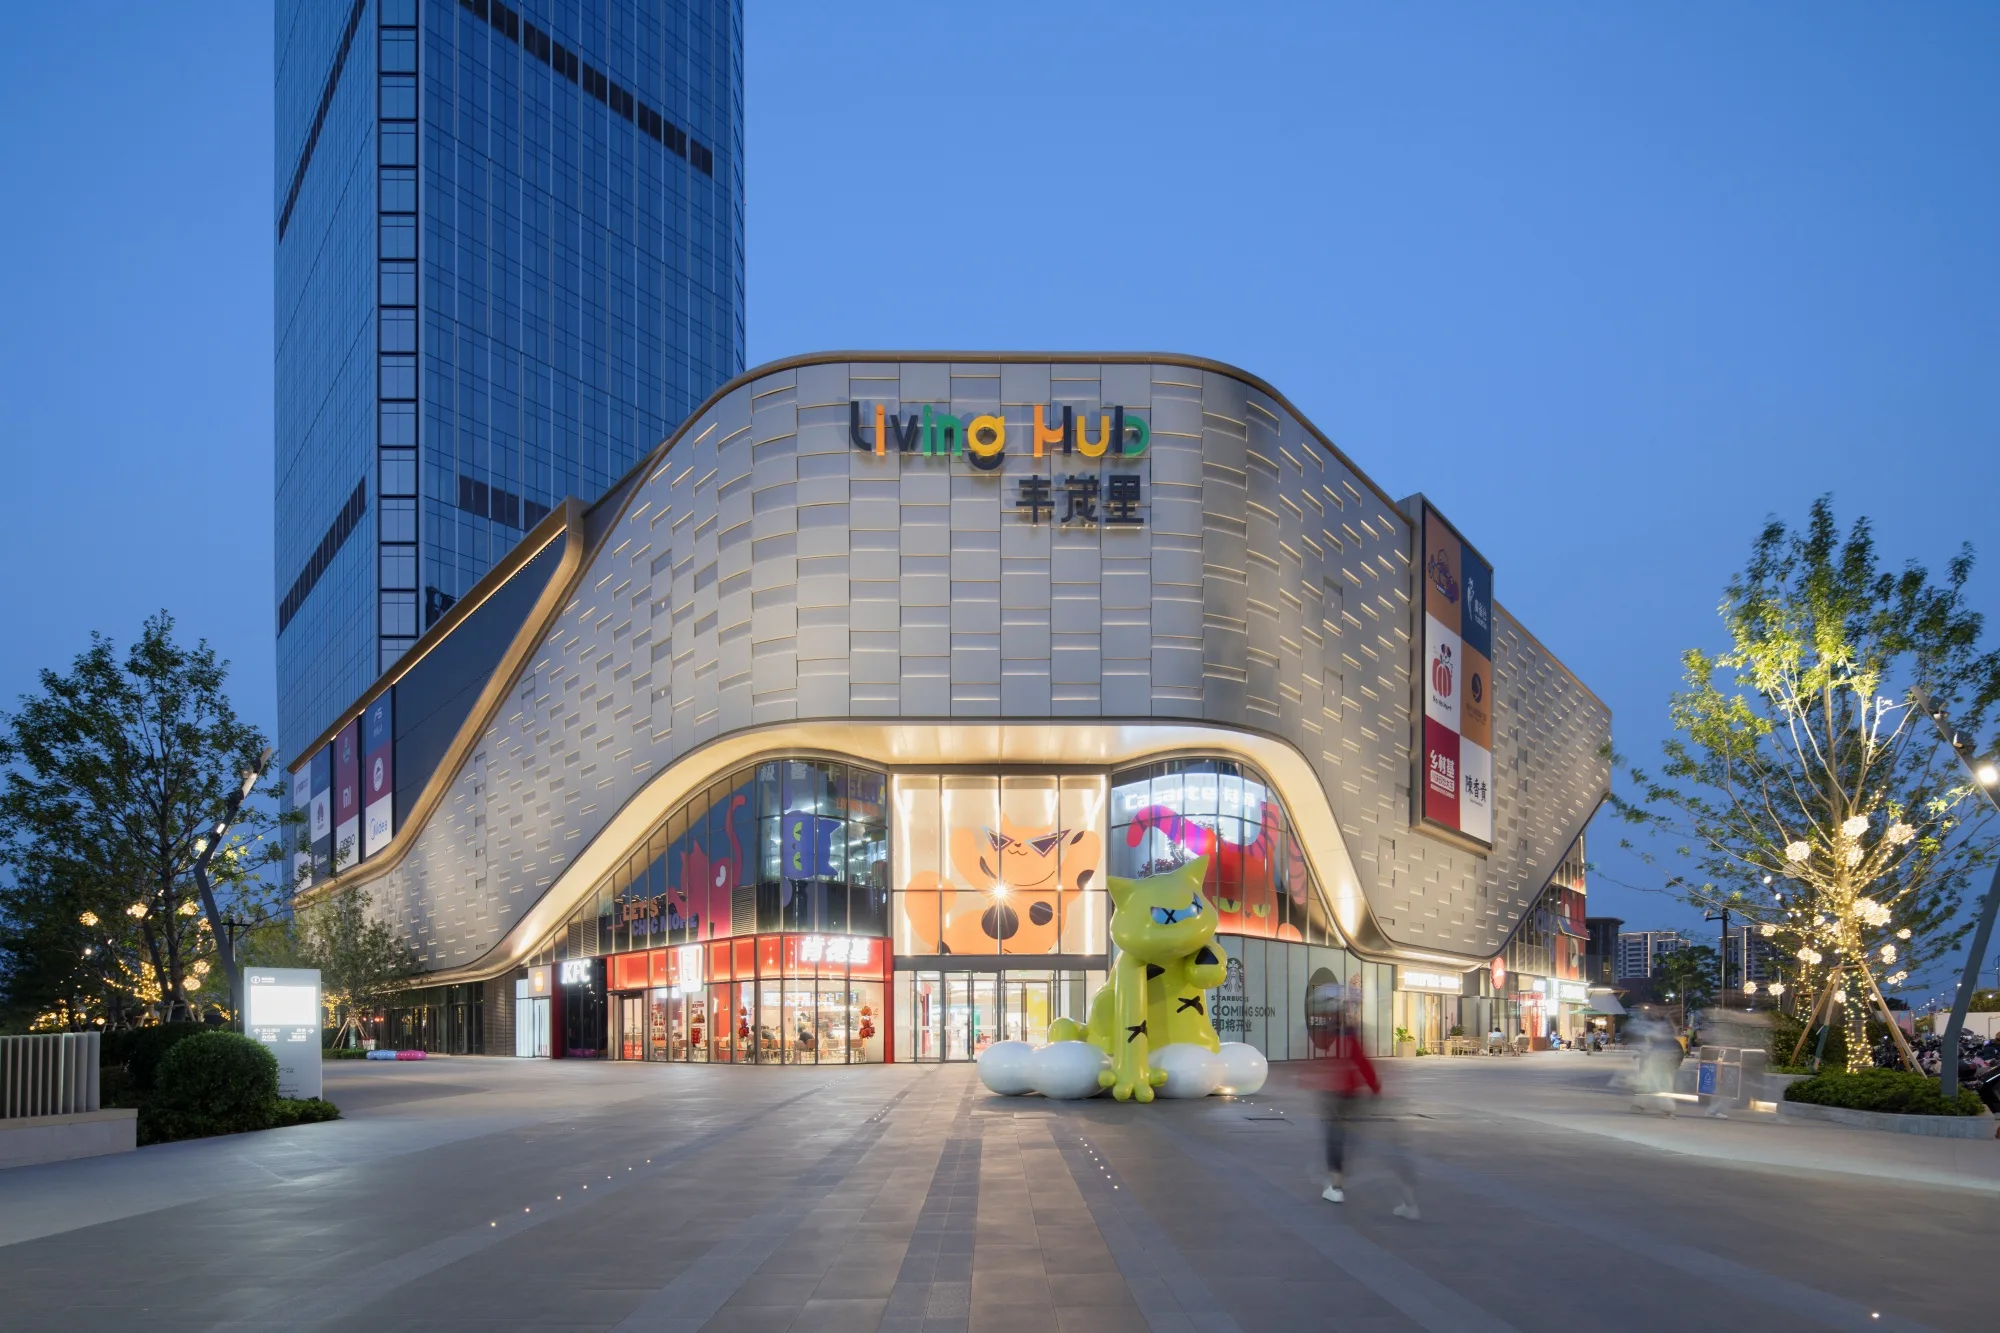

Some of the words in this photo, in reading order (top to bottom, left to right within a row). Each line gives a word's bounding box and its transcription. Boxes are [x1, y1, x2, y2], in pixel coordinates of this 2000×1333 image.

[850, 400, 1005, 471] Living
[1033, 404, 1150, 458] Hub
[1016, 474, 1145, 525] 丰茂里
[1125, 785, 1217, 810] Casarte
[370, 817, 387, 840] Midea
[622, 899, 659, 921] LET'S
[632, 917, 658, 936] CHC
[562, 961, 592, 982] KFC
[1212, 1004, 1253, 1017] COMING
[1254, 1006, 1276, 1018] SOON
[1212, 1018, 1252, 1032] 即将开业
